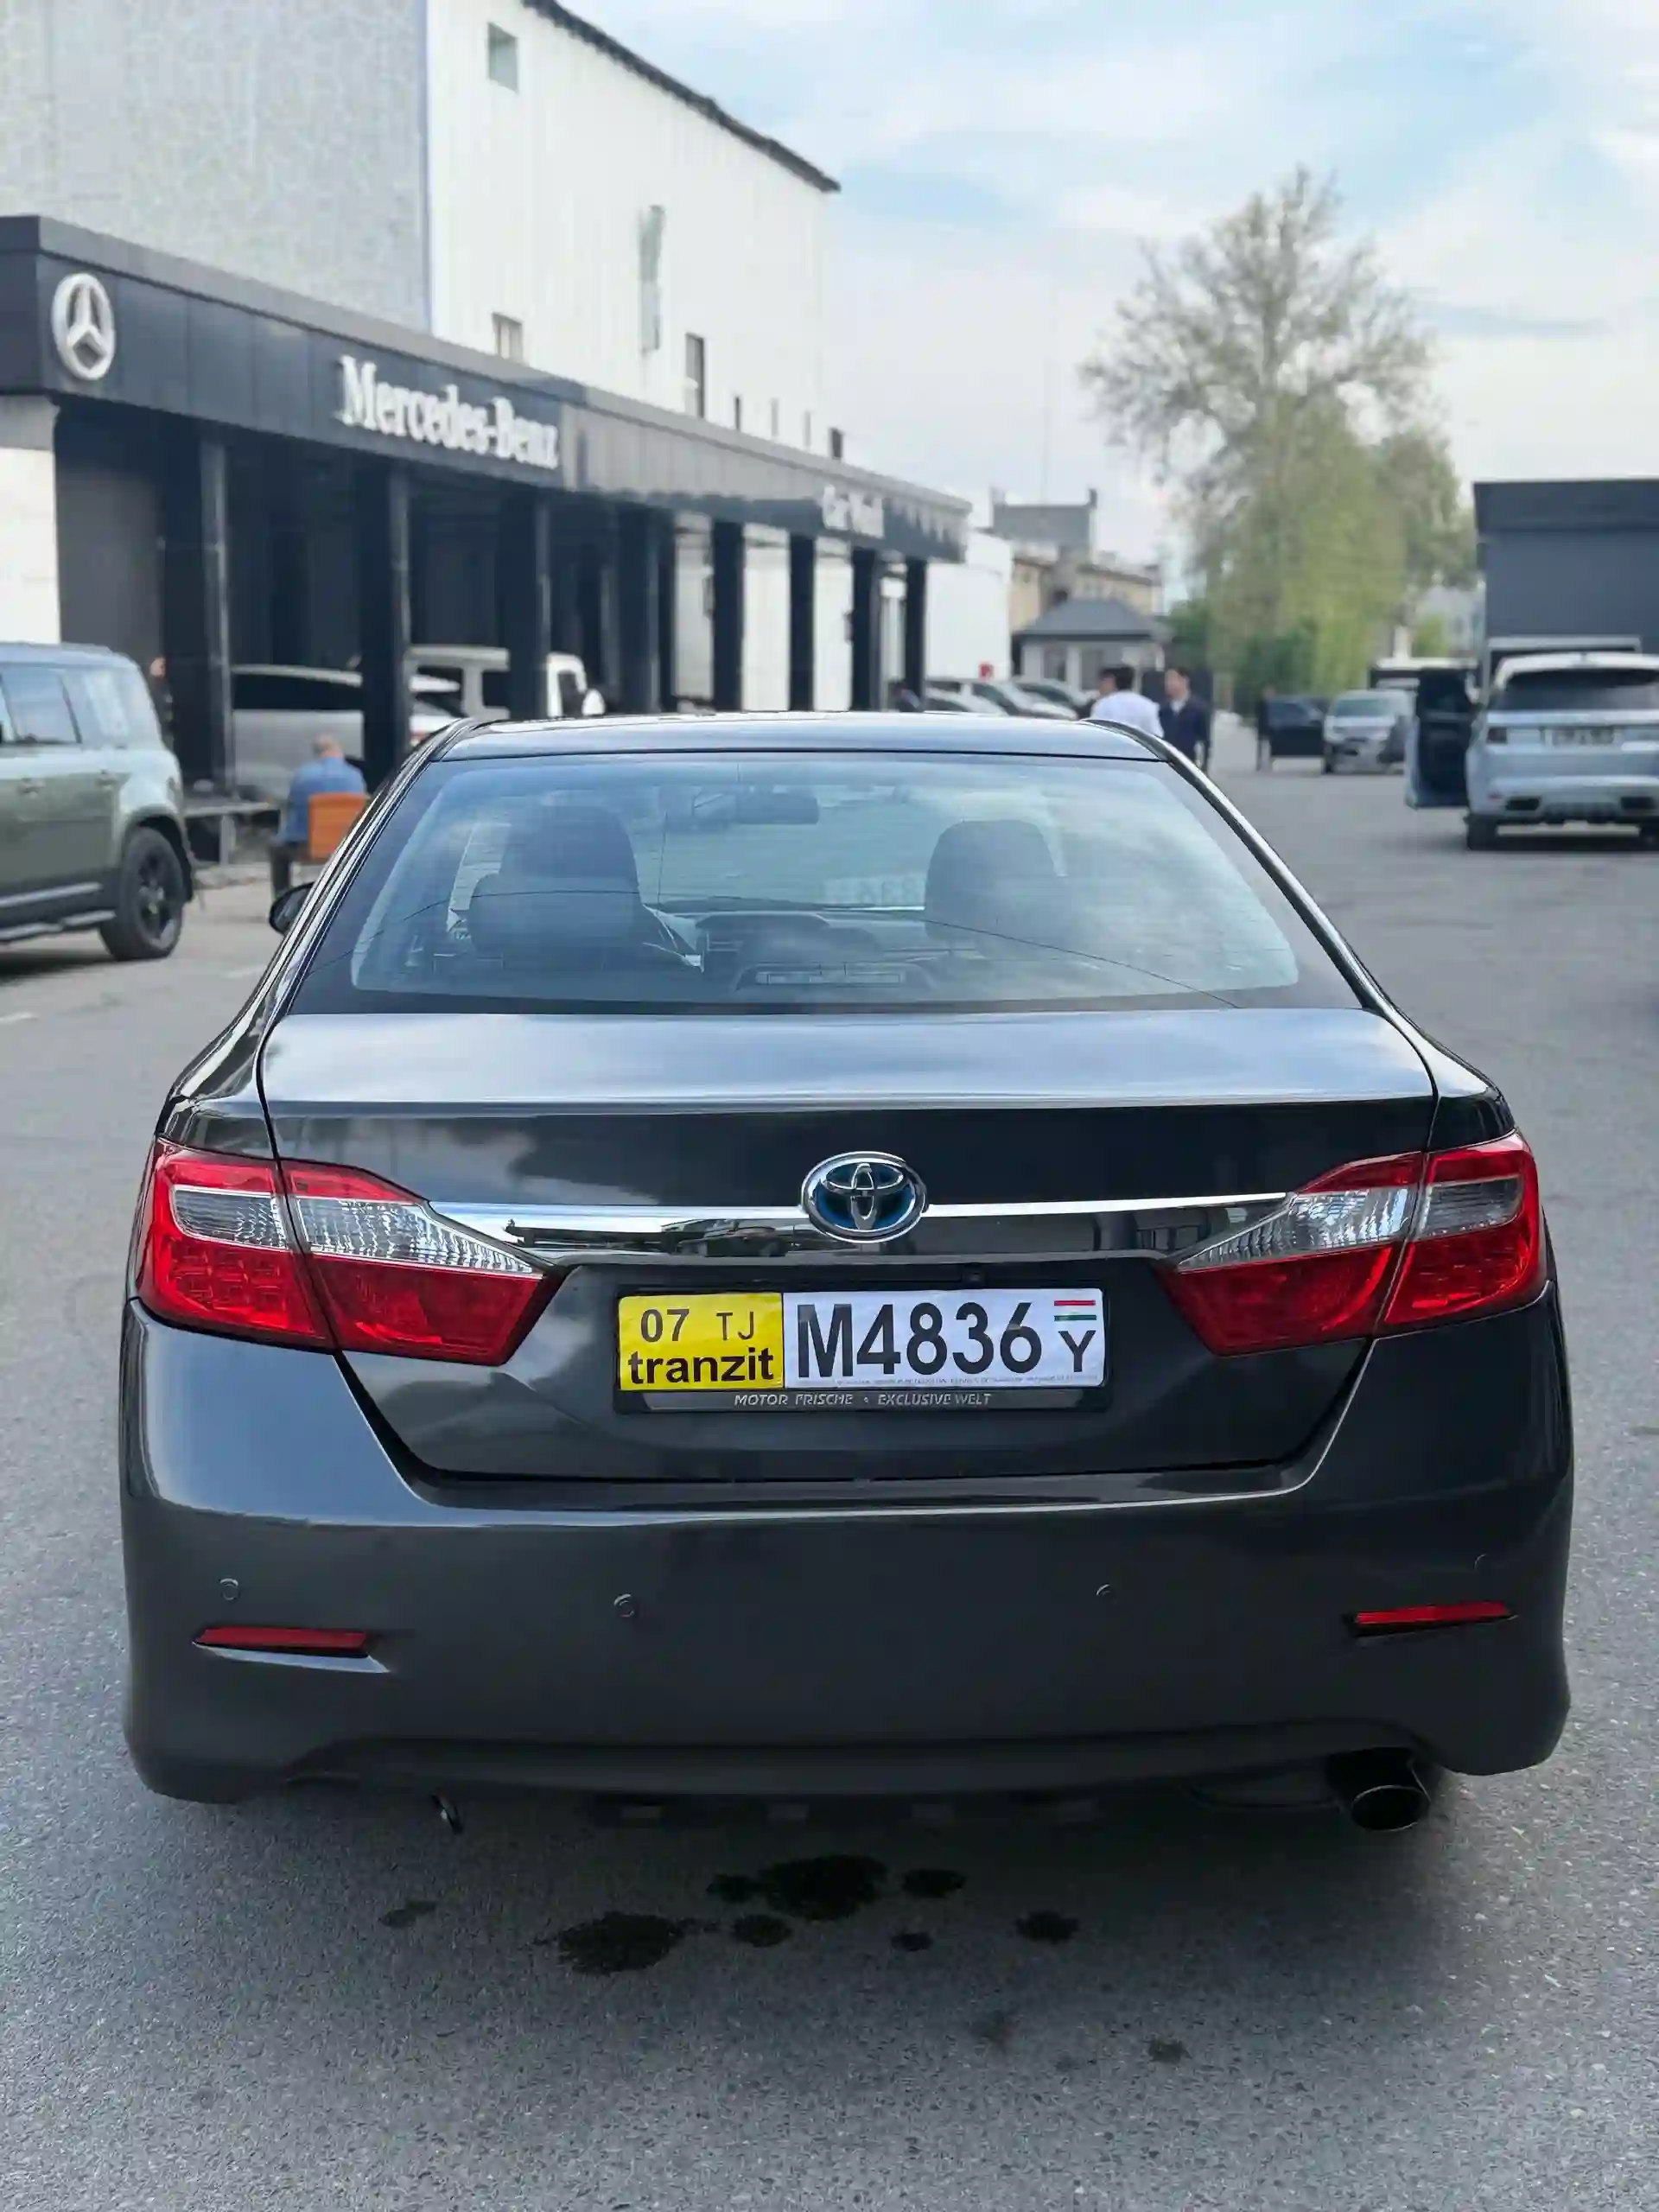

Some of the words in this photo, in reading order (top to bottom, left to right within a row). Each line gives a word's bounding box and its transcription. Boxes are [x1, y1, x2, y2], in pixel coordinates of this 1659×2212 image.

[337, 355, 558, 469] Mercedes-Benz
[640, 1308, 690, 1343] 07
[715, 1311, 754, 1341] TJ
[797, 1302, 1043, 1378] M4836
[628, 1346, 774, 1384] tranzit
[1058, 1330, 1096, 1373] Y
[734, 1393, 788, 1407] MOTOR
[878, 1393, 951, 1407] EXCLUSIVE
[955, 1393, 993, 1407] WELT
